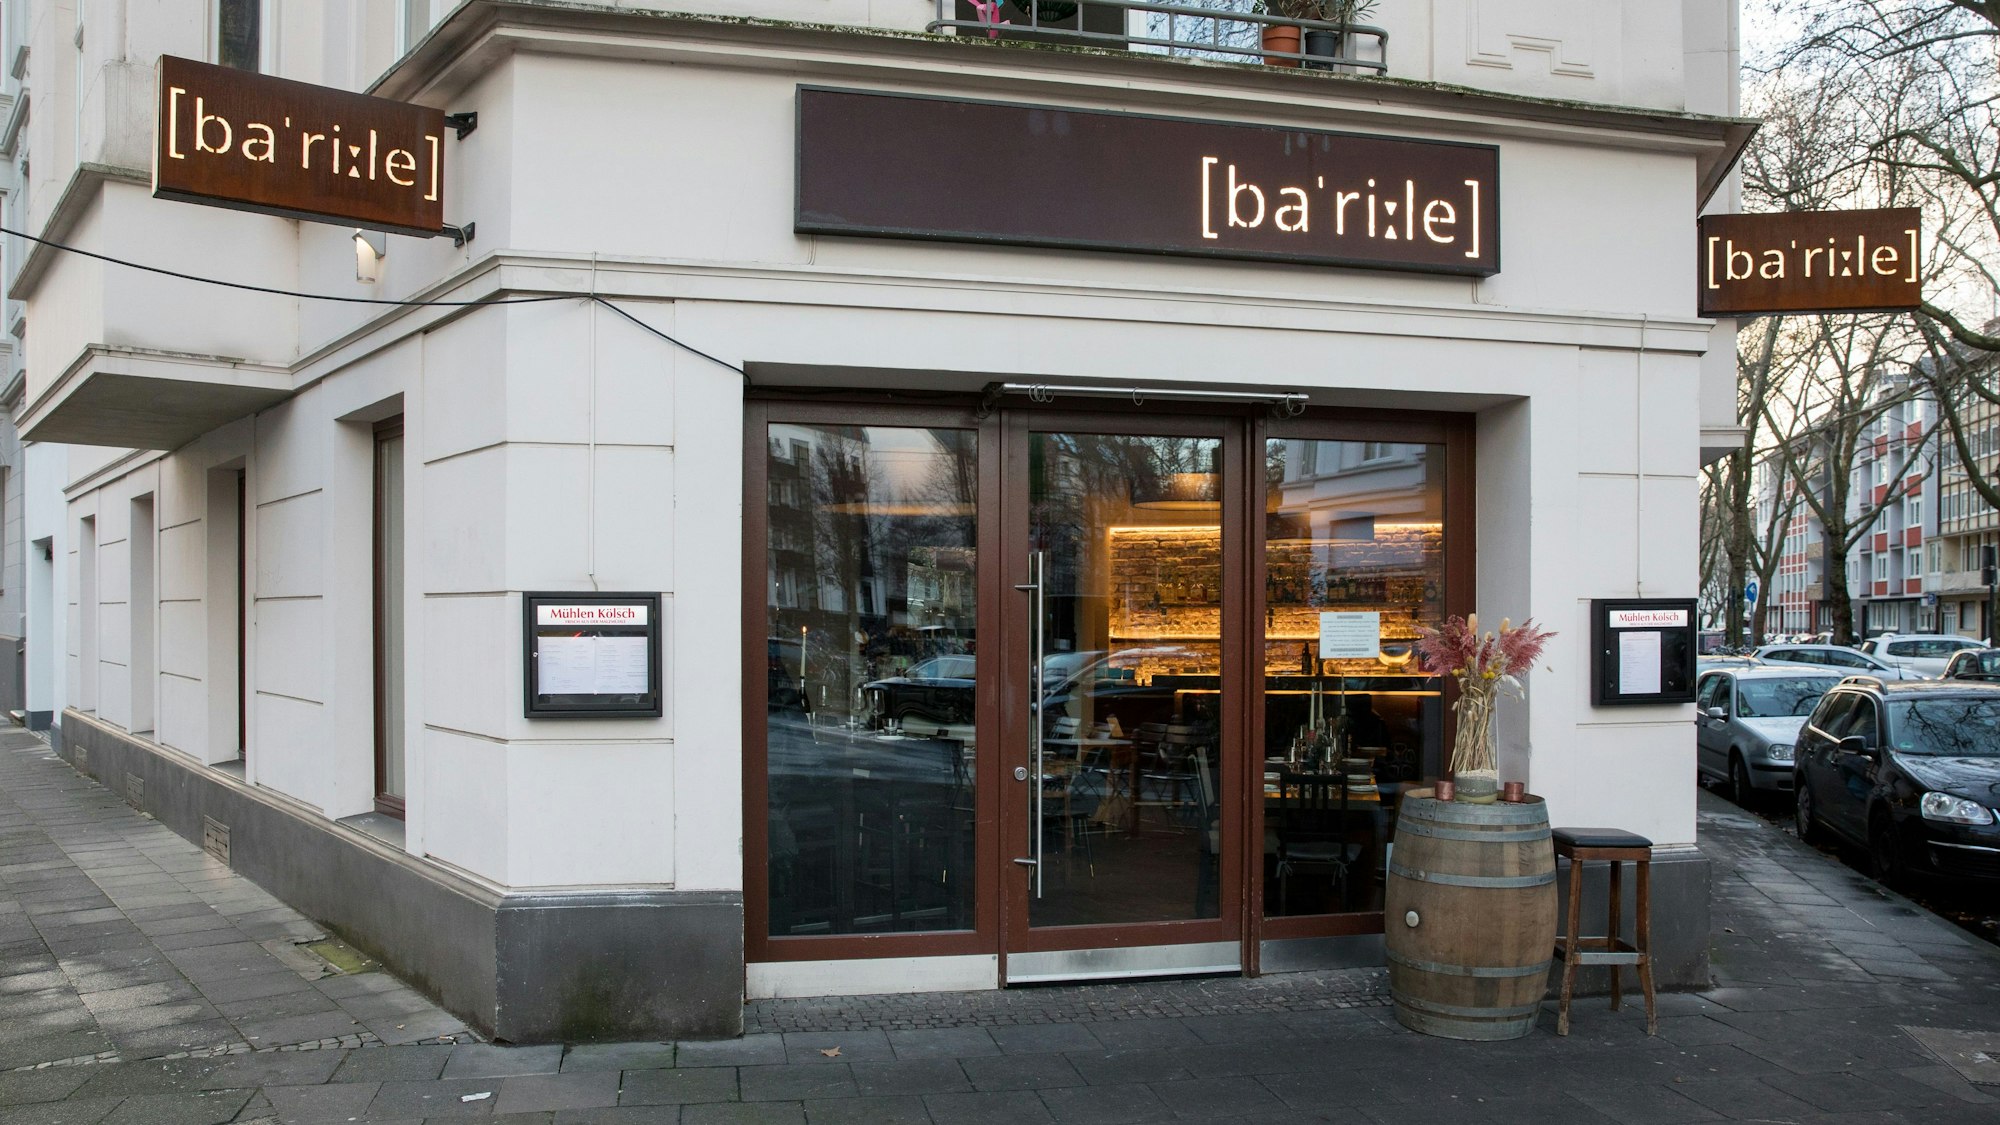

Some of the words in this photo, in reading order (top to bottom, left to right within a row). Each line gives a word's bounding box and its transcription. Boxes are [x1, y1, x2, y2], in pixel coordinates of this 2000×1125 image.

[550, 607, 594, 619] Mühlen
[598, 607, 636, 619] Kölsch
[1619, 612, 1650, 622] Mühlen
[1652, 611, 1679, 622] Kölsch
